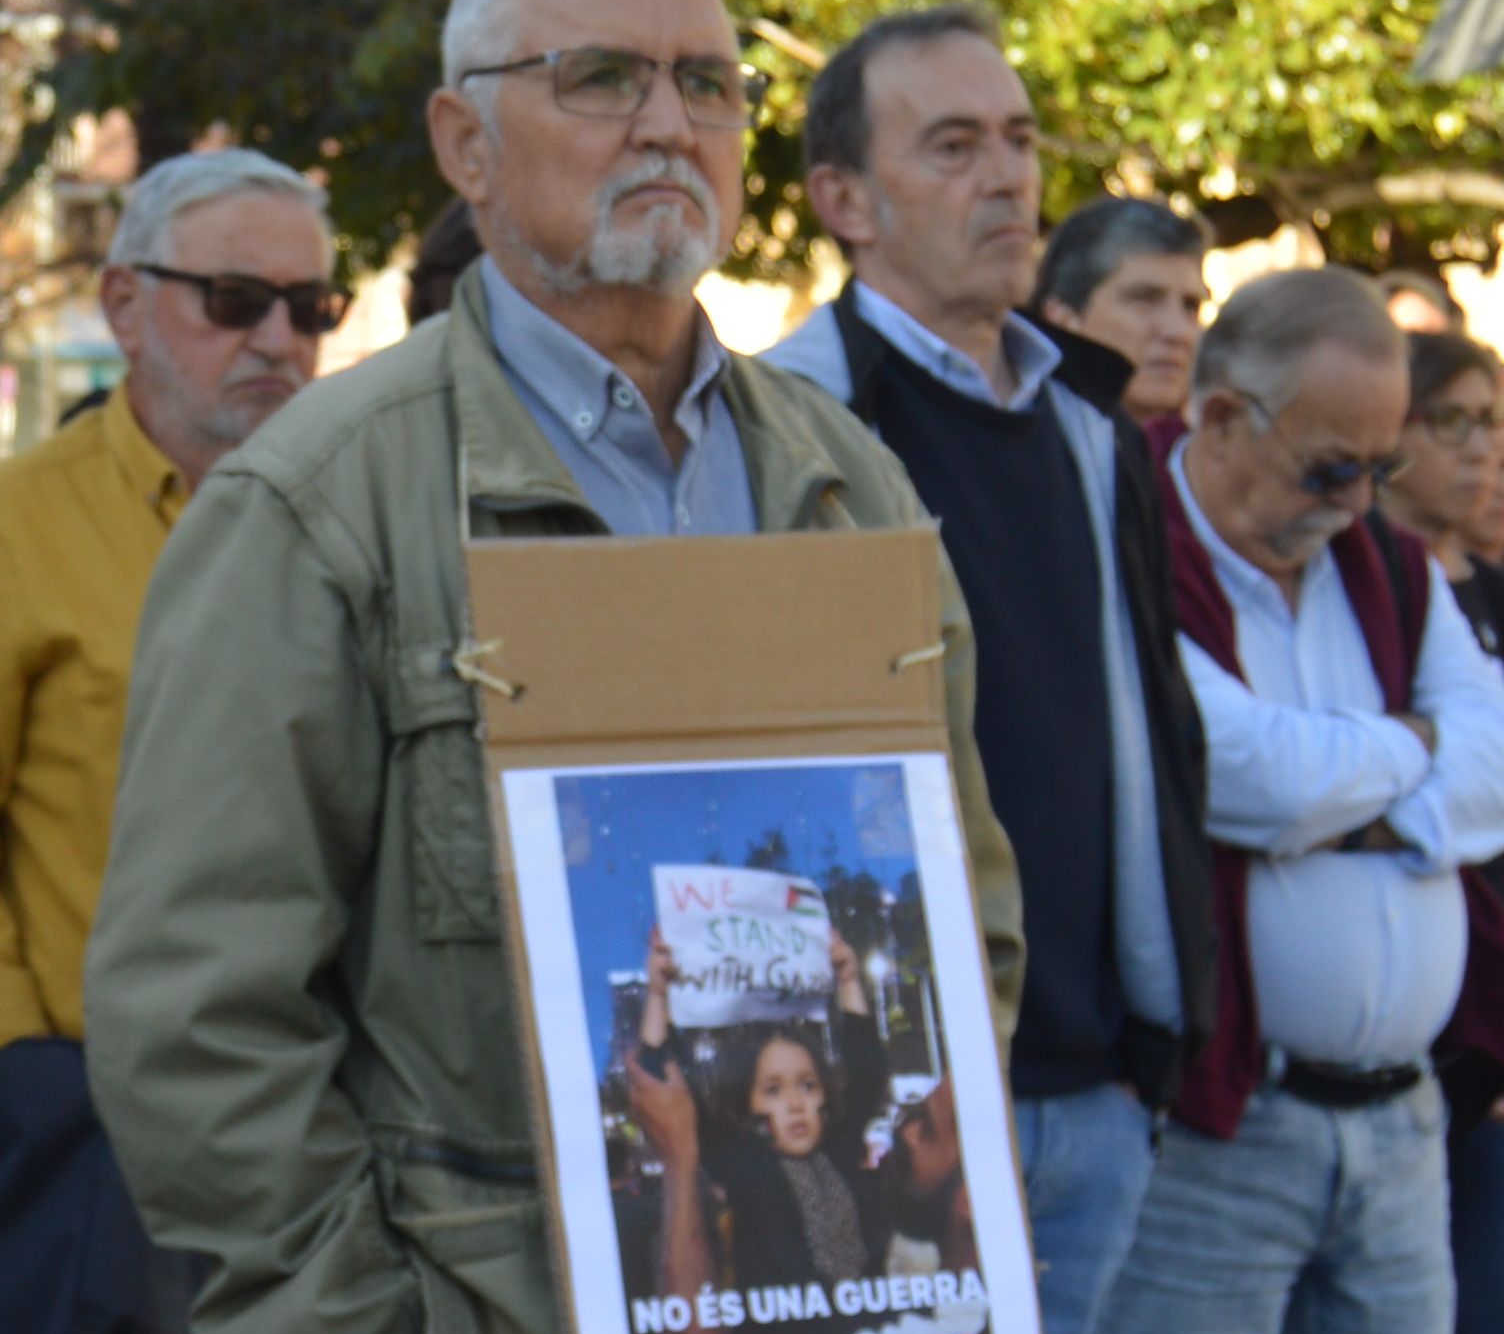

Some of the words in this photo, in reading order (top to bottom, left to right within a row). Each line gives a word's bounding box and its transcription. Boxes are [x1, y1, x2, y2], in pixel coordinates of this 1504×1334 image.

[668, 876, 736, 913] WE
[706, 915, 808, 955] STAND
[694, 1280, 745, 1329] ÉS
[747, 1281, 832, 1324] UNA
[833, 1268, 991, 1317] GUERRA
